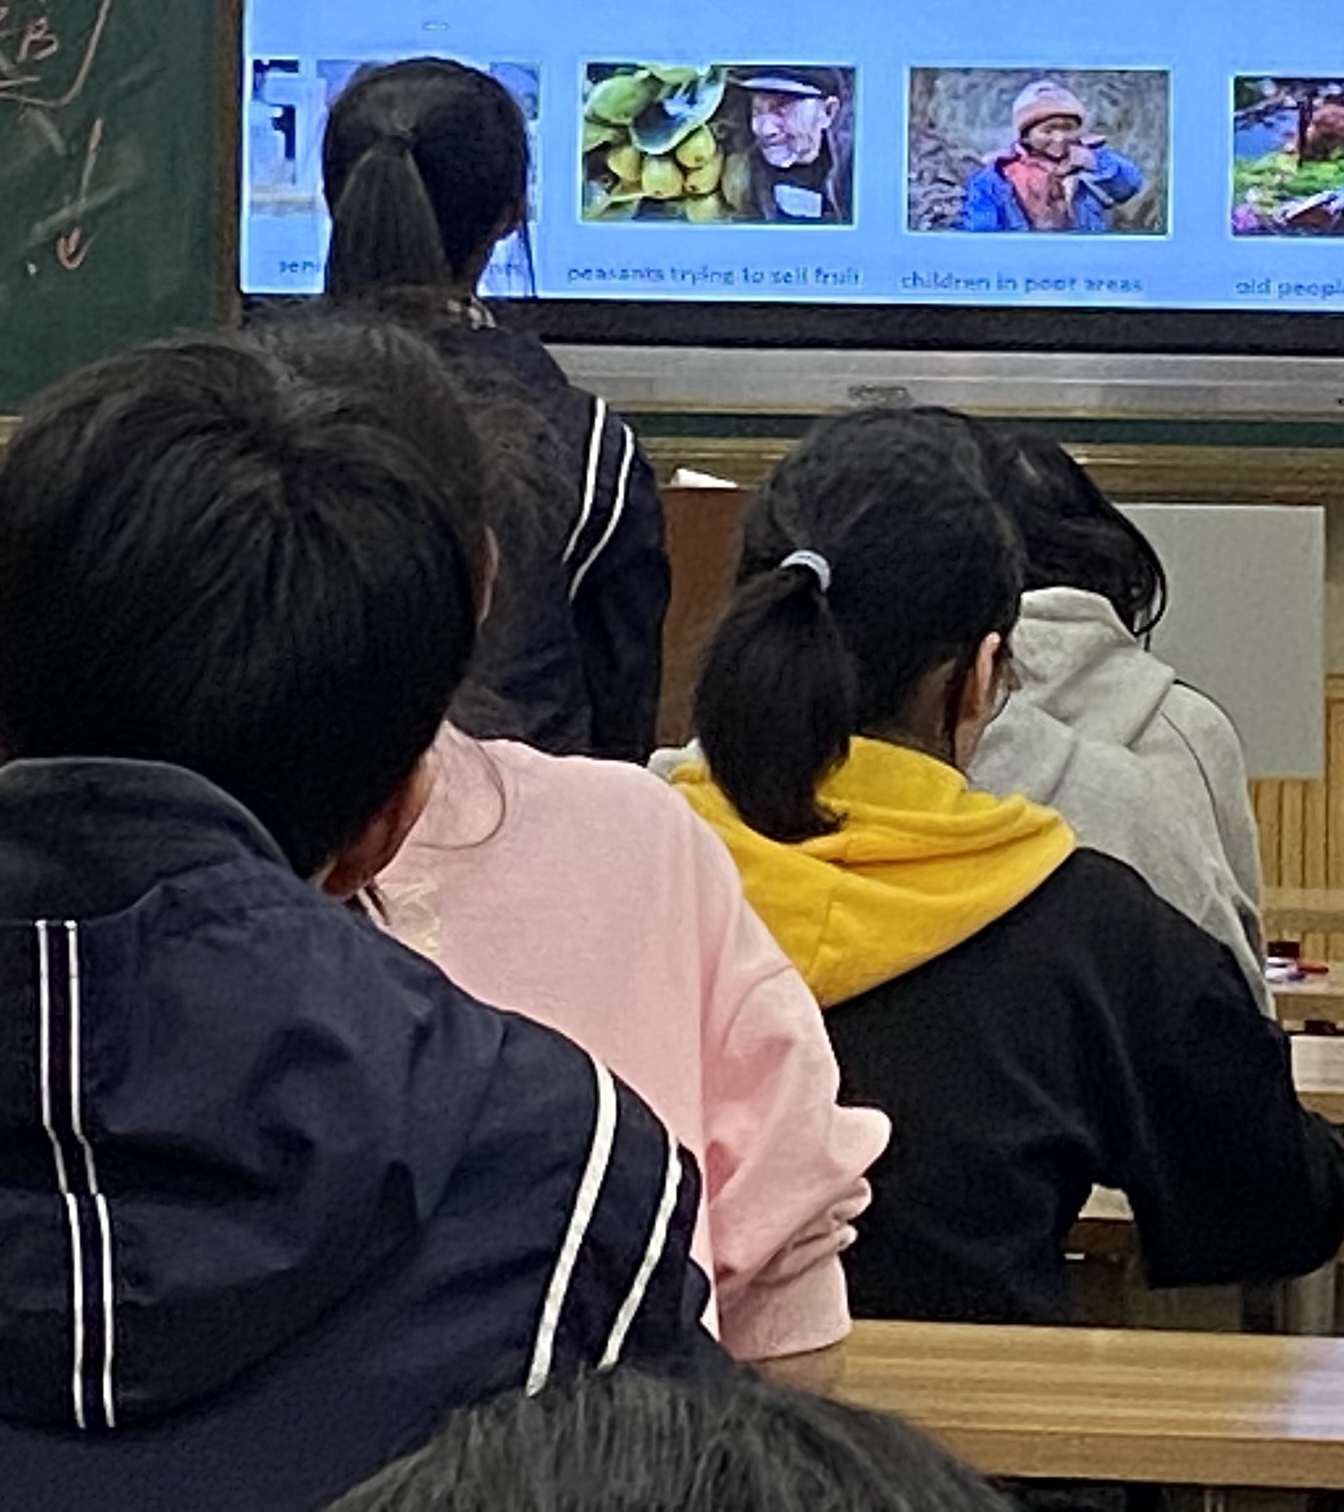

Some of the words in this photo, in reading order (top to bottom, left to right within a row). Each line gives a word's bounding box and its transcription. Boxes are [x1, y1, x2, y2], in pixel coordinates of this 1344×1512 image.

[567, 266, 665, 284] peasants
[670, 265, 736, 286] trying
[742, 266, 765, 284] to
[772, 266, 808, 285] sell
[814, 266, 863, 286] fruit
[901, 270, 990, 291] children
[997, 271, 1018, 292] in
[1025, 276, 1076, 294] poor
[1083, 277, 1144, 293] areas
[1235, 277, 1273, 297] old
